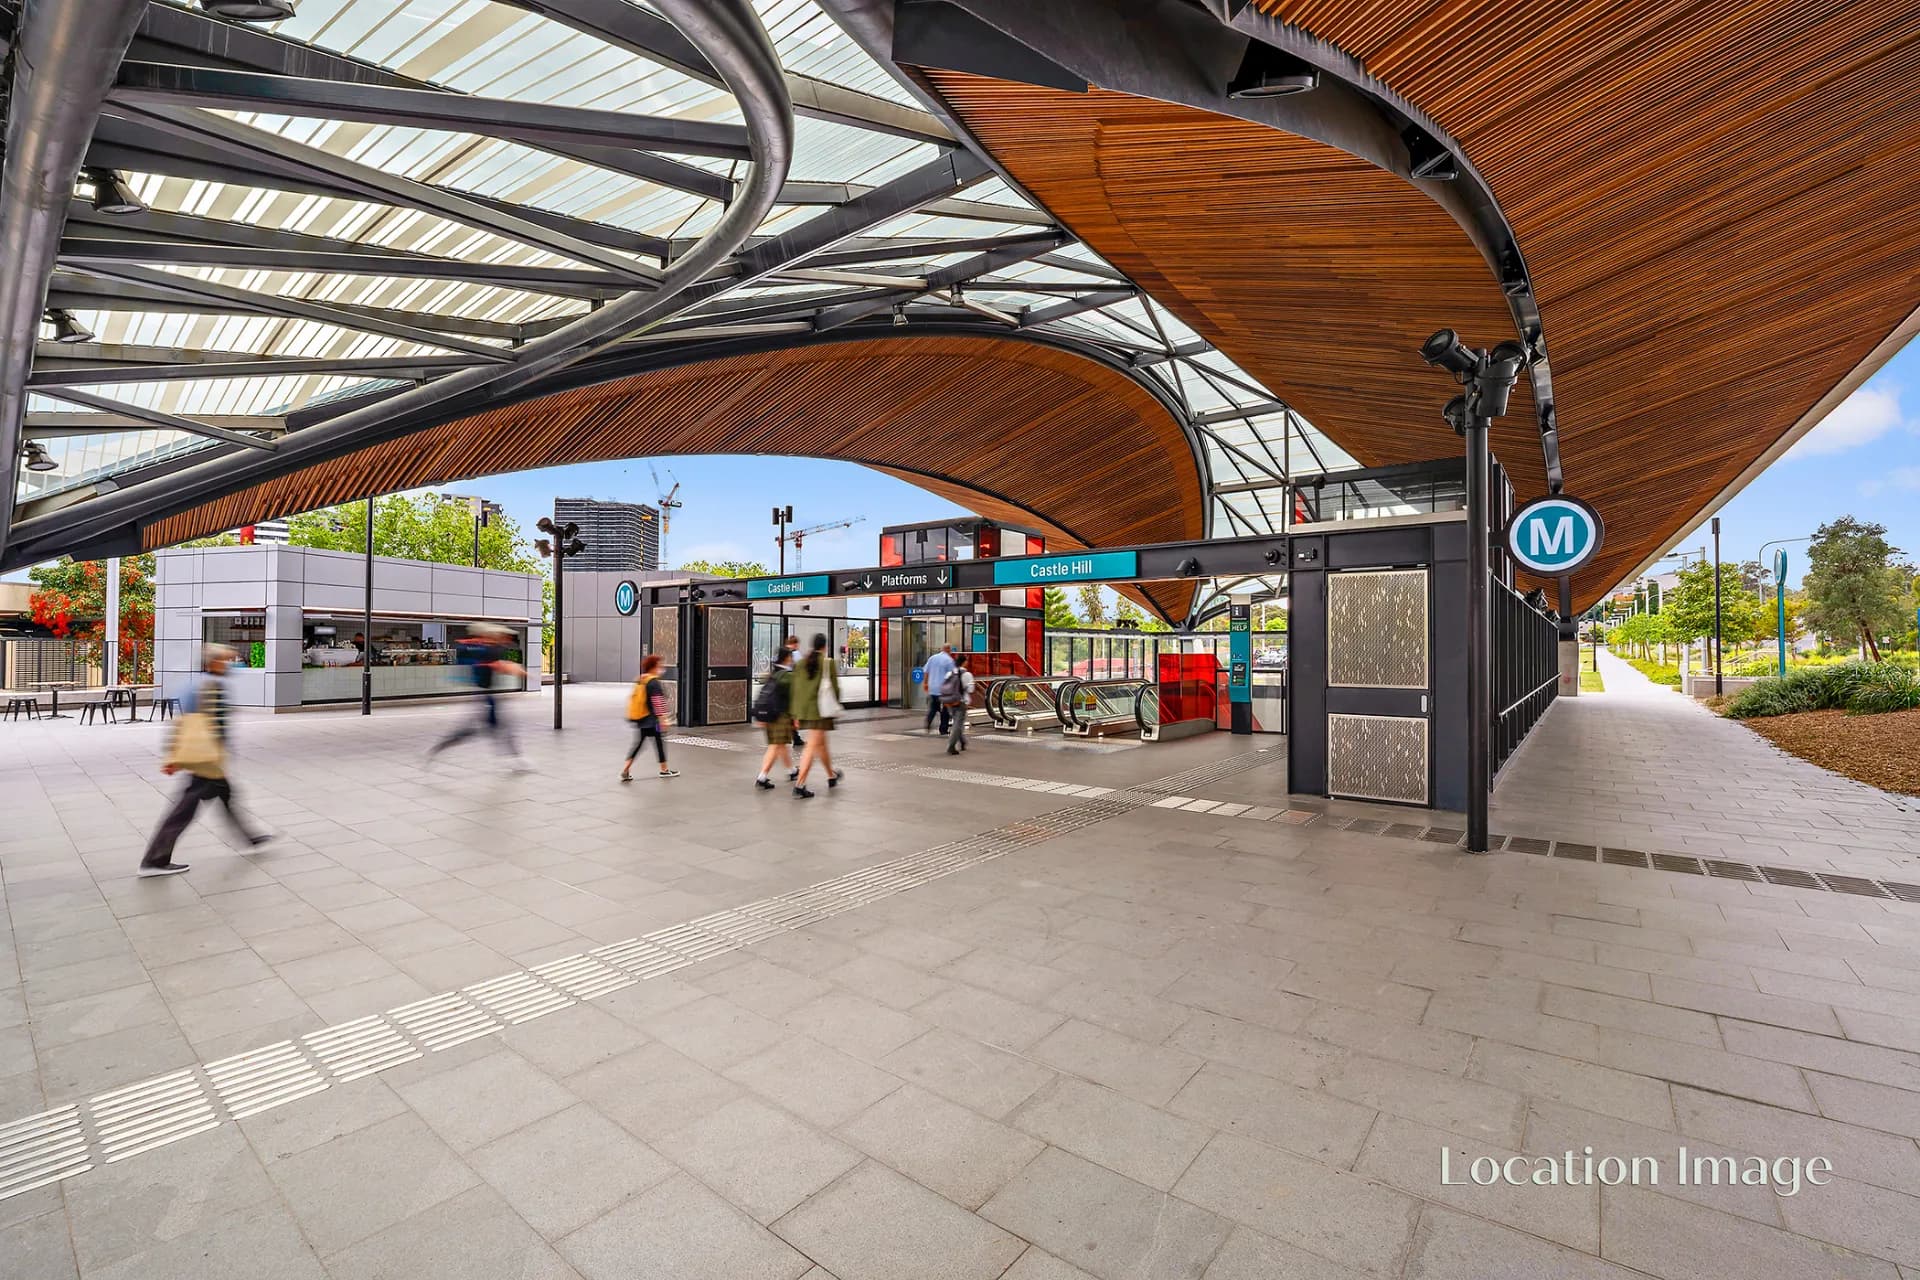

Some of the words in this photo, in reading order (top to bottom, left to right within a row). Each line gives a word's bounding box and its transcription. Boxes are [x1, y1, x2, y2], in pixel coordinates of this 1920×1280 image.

[1530, 516, 1574, 556] M
[1030, 562, 1069, 578] Castle
[1072, 559, 1092, 575] Hill
[767, 583, 791, 594] Castle
[791, 581, 804, 592] Hill
[881, 574, 928, 587] Platforms
[620, 589, 631, 607] M
[1231, 624, 1248, 632] HELP
